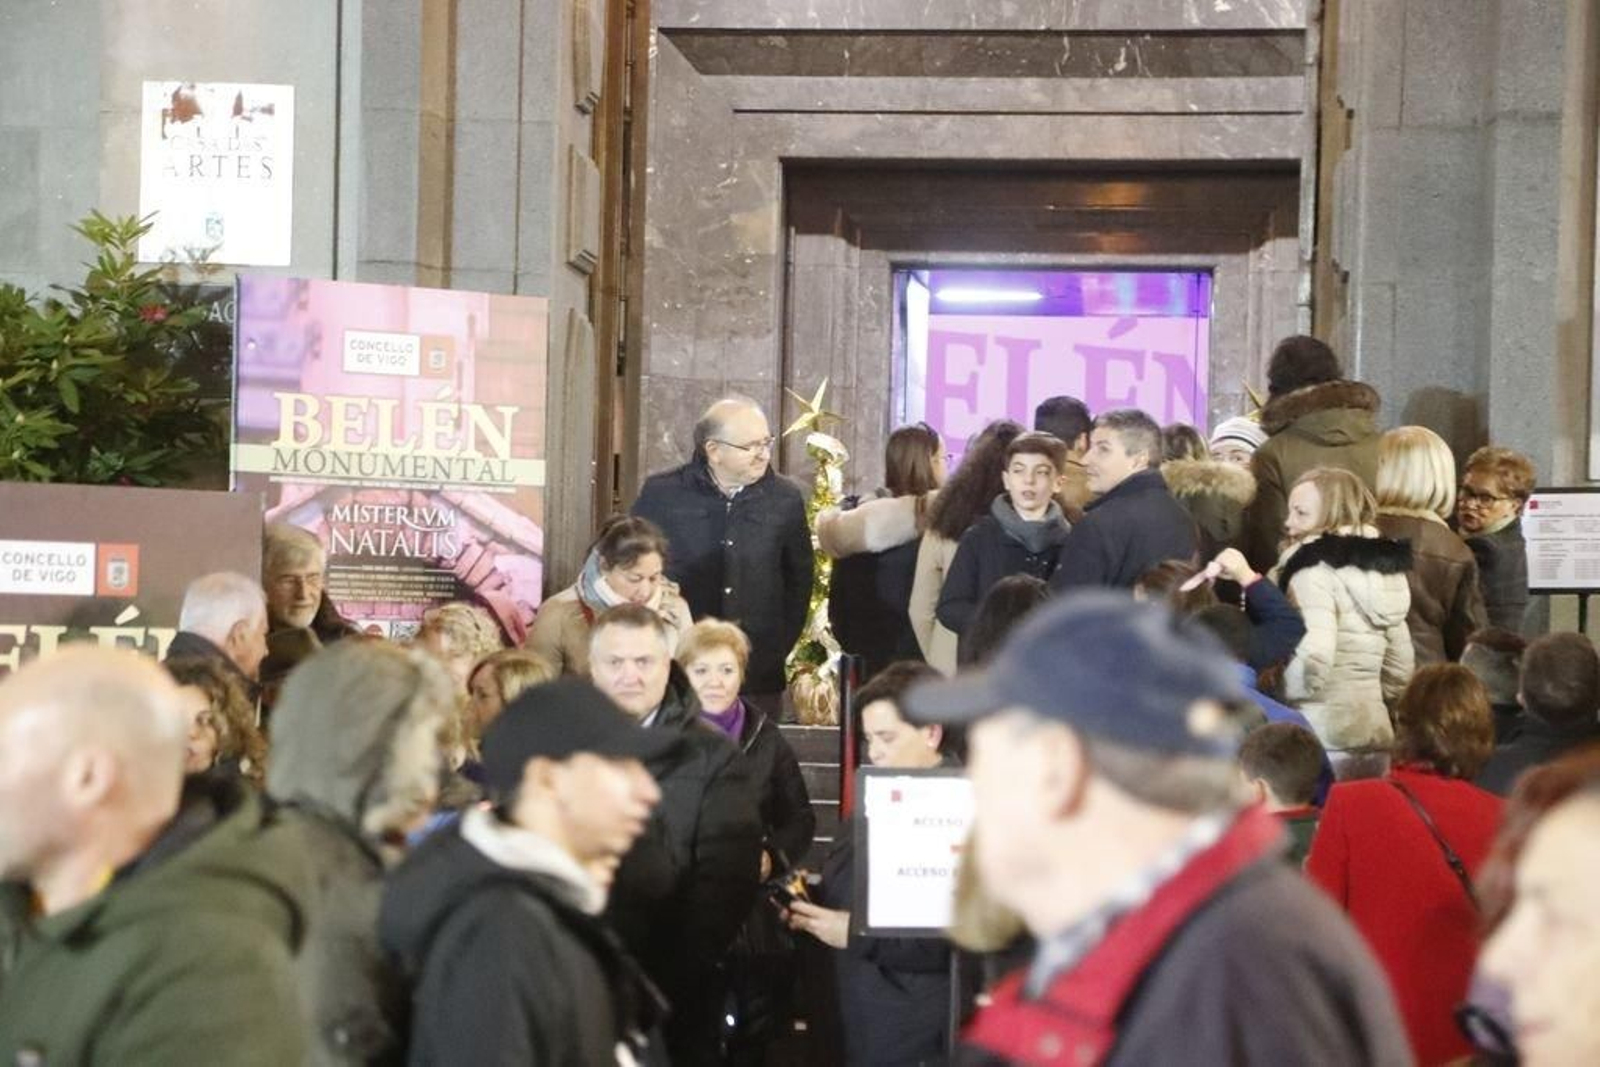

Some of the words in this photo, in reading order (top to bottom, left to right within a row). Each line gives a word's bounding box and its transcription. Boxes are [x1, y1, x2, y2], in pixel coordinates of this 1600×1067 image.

[162, 154, 274, 180] ARTES
[349, 337, 415, 355] CONCELLO
[356, 352, 374, 364] DE
[376, 353, 407, 367] VIGO
[270, 384, 520, 460] BELÉN
[272, 448, 517, 483] MONUMENTAL
[331, 527, 458, 559] NATALIS
[1, 551, 87, 567] CONCELLO
[11, 568, 33, 582] DE
[39, 569, 77, 583] VIGO
[913, 817, 963, 826] ACCESO
[897, 867, 948, 877] ACCESO
